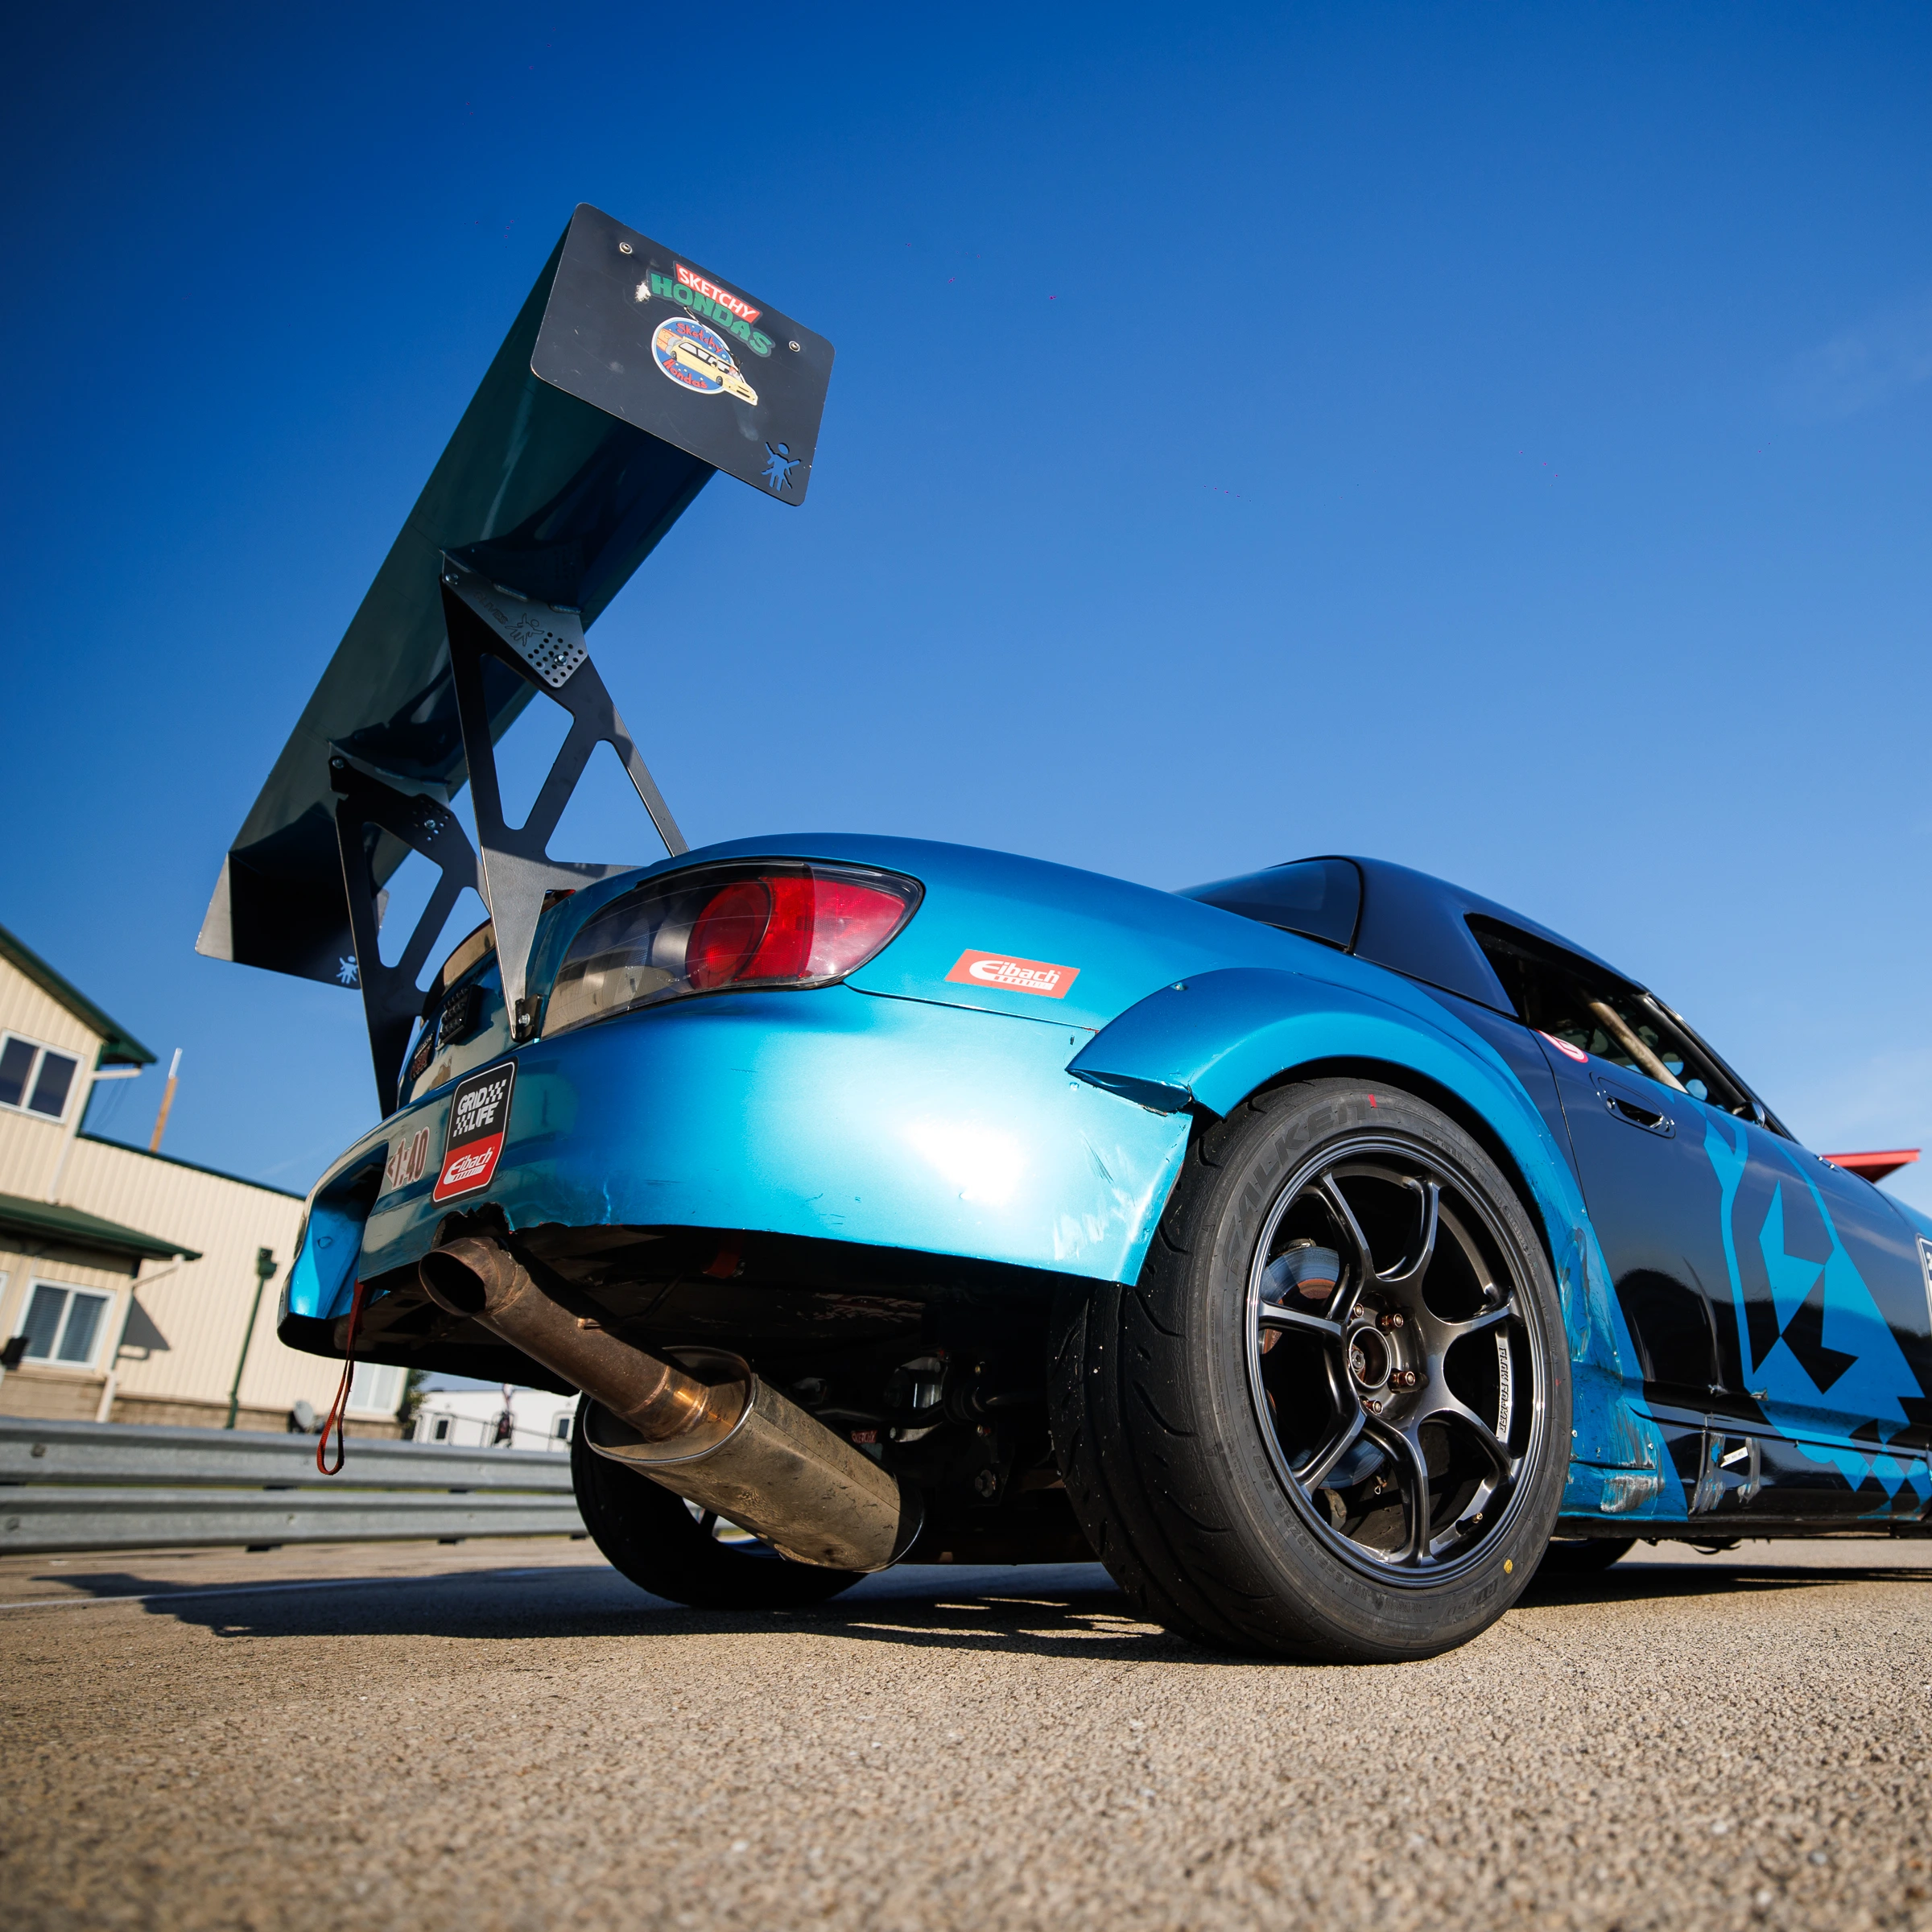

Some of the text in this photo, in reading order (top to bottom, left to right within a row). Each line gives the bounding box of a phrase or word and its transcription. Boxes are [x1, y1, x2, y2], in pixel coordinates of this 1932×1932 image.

[679, 267, 756, 318] SKETCHY
[650, 273, 773, 355] HONDAS
[676, 323, 724, 353] Sketchy
[663, 358, 708, 389] Hondas
[969, 960, 1060, 990] Eibach
[457, 1087, 488, 1116] GRID
[468, 1101, 500, 1131] LIFE
[444, 1146, 493, 1185] Eibach
[1222, 1097, 1368, 1278] FALKEN
